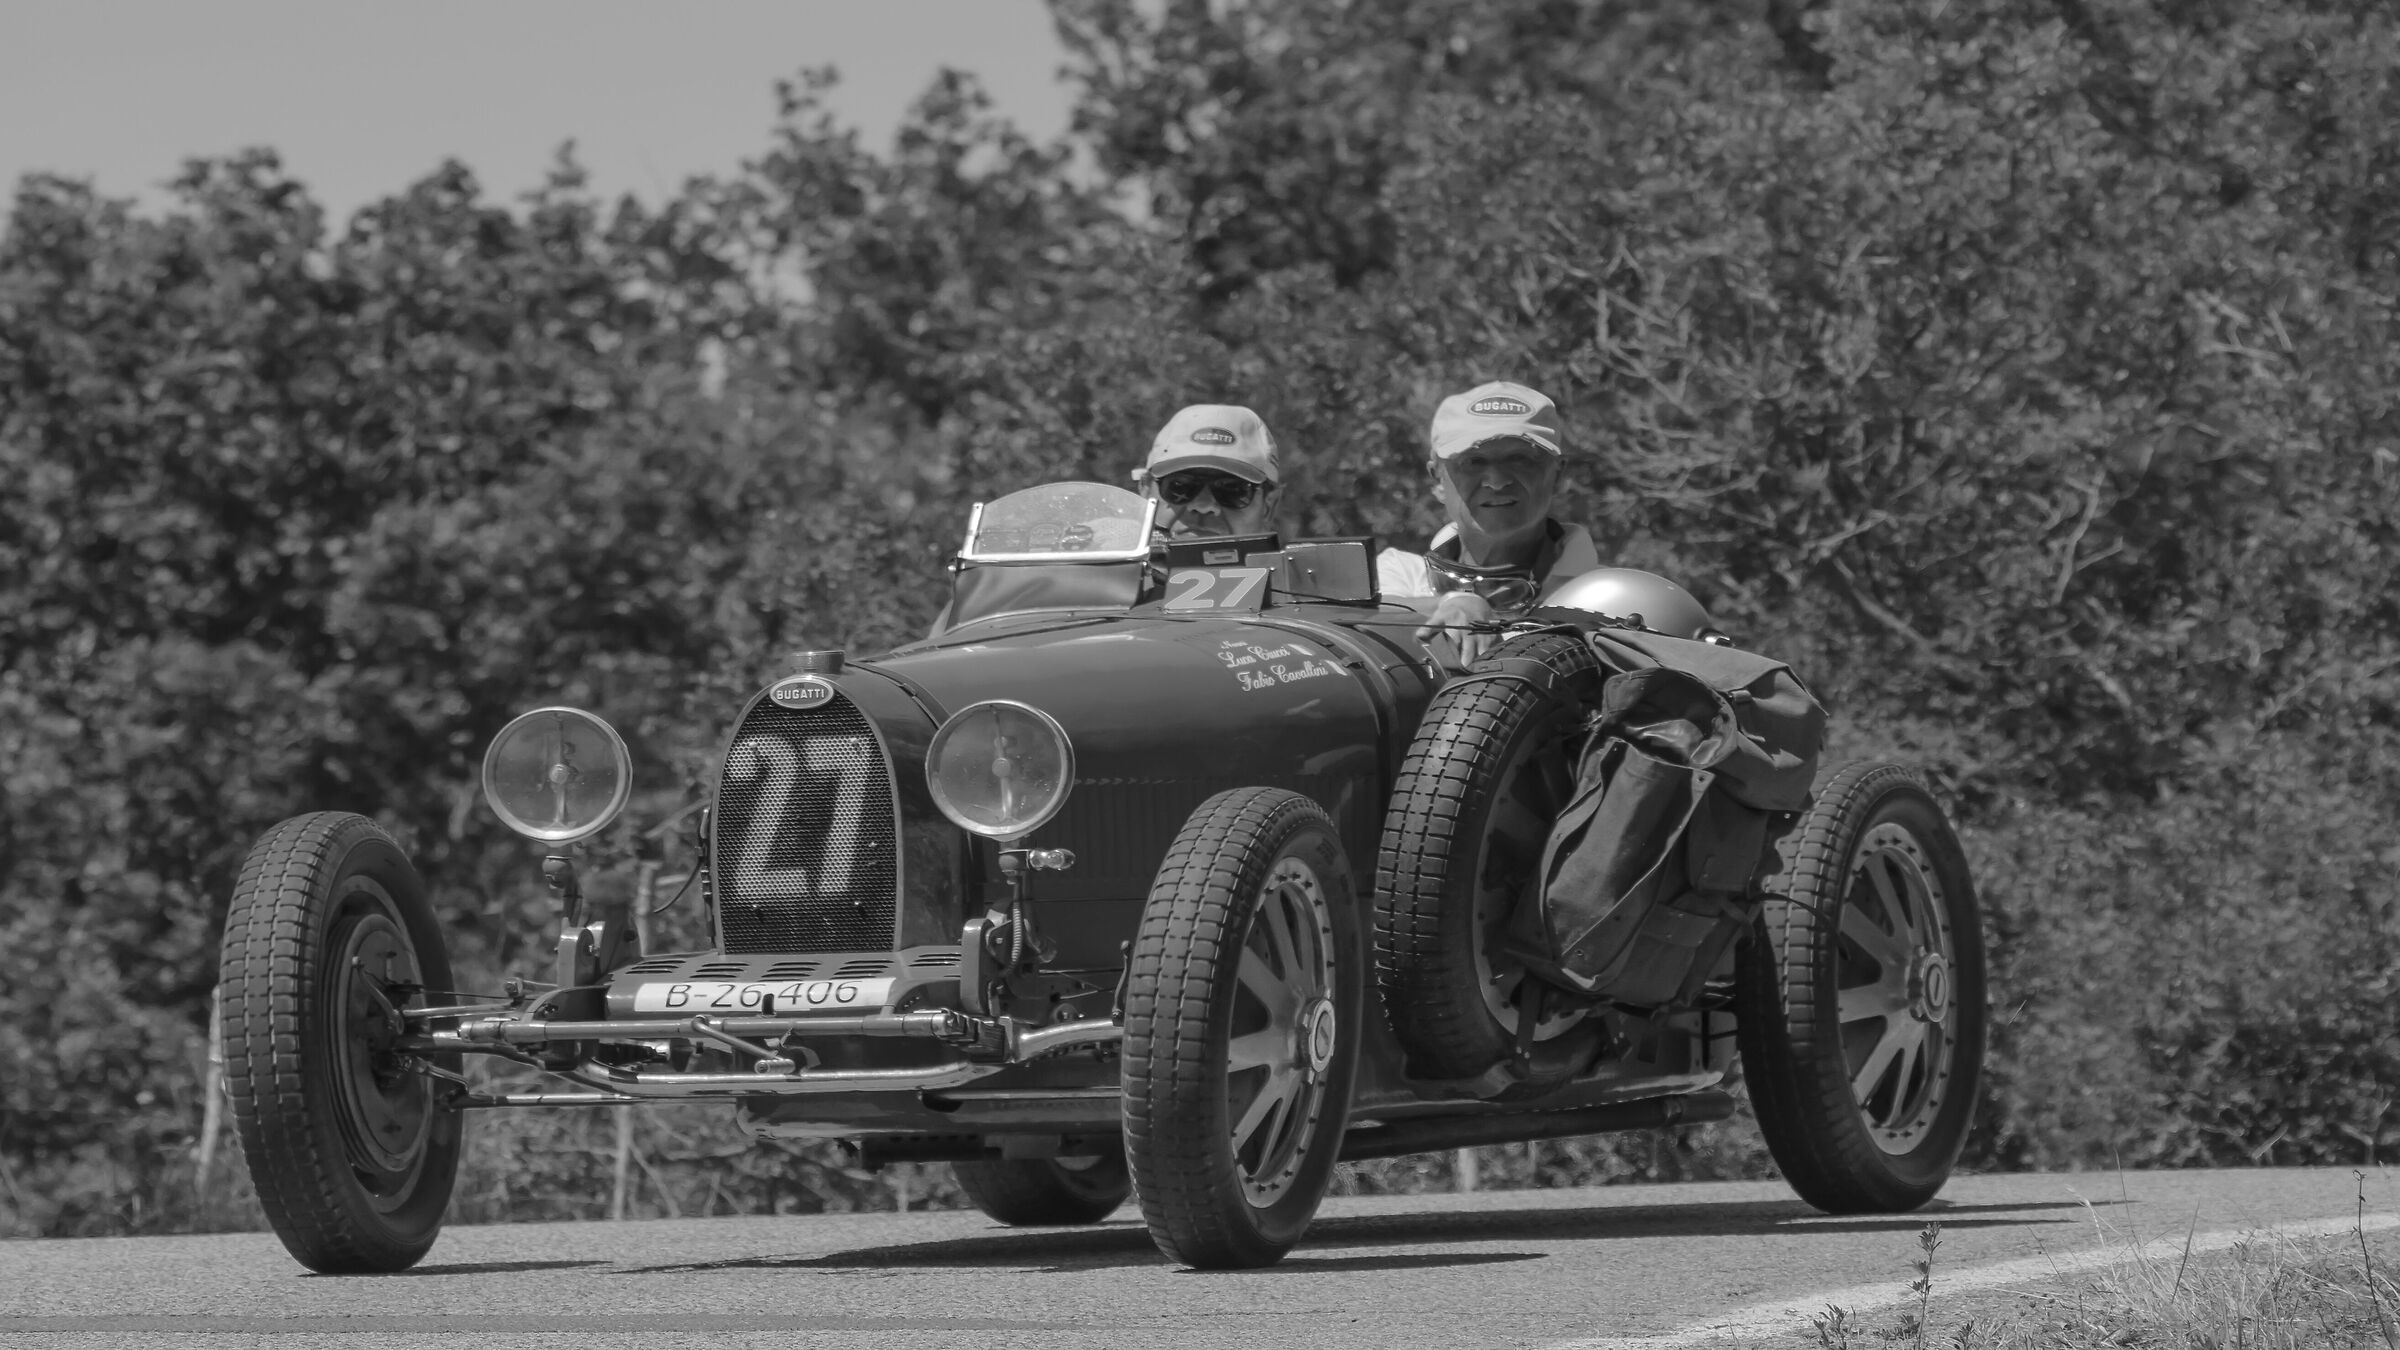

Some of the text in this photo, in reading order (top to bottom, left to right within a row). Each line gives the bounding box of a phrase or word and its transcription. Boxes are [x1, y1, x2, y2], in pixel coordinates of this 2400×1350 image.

[1474, 401, 1527, 413] BUGATTI
[1164, 568, 1267, 610] 27
[776, 688, 825, 700] BUGATTI
[728, 733, 876, 897] 27
